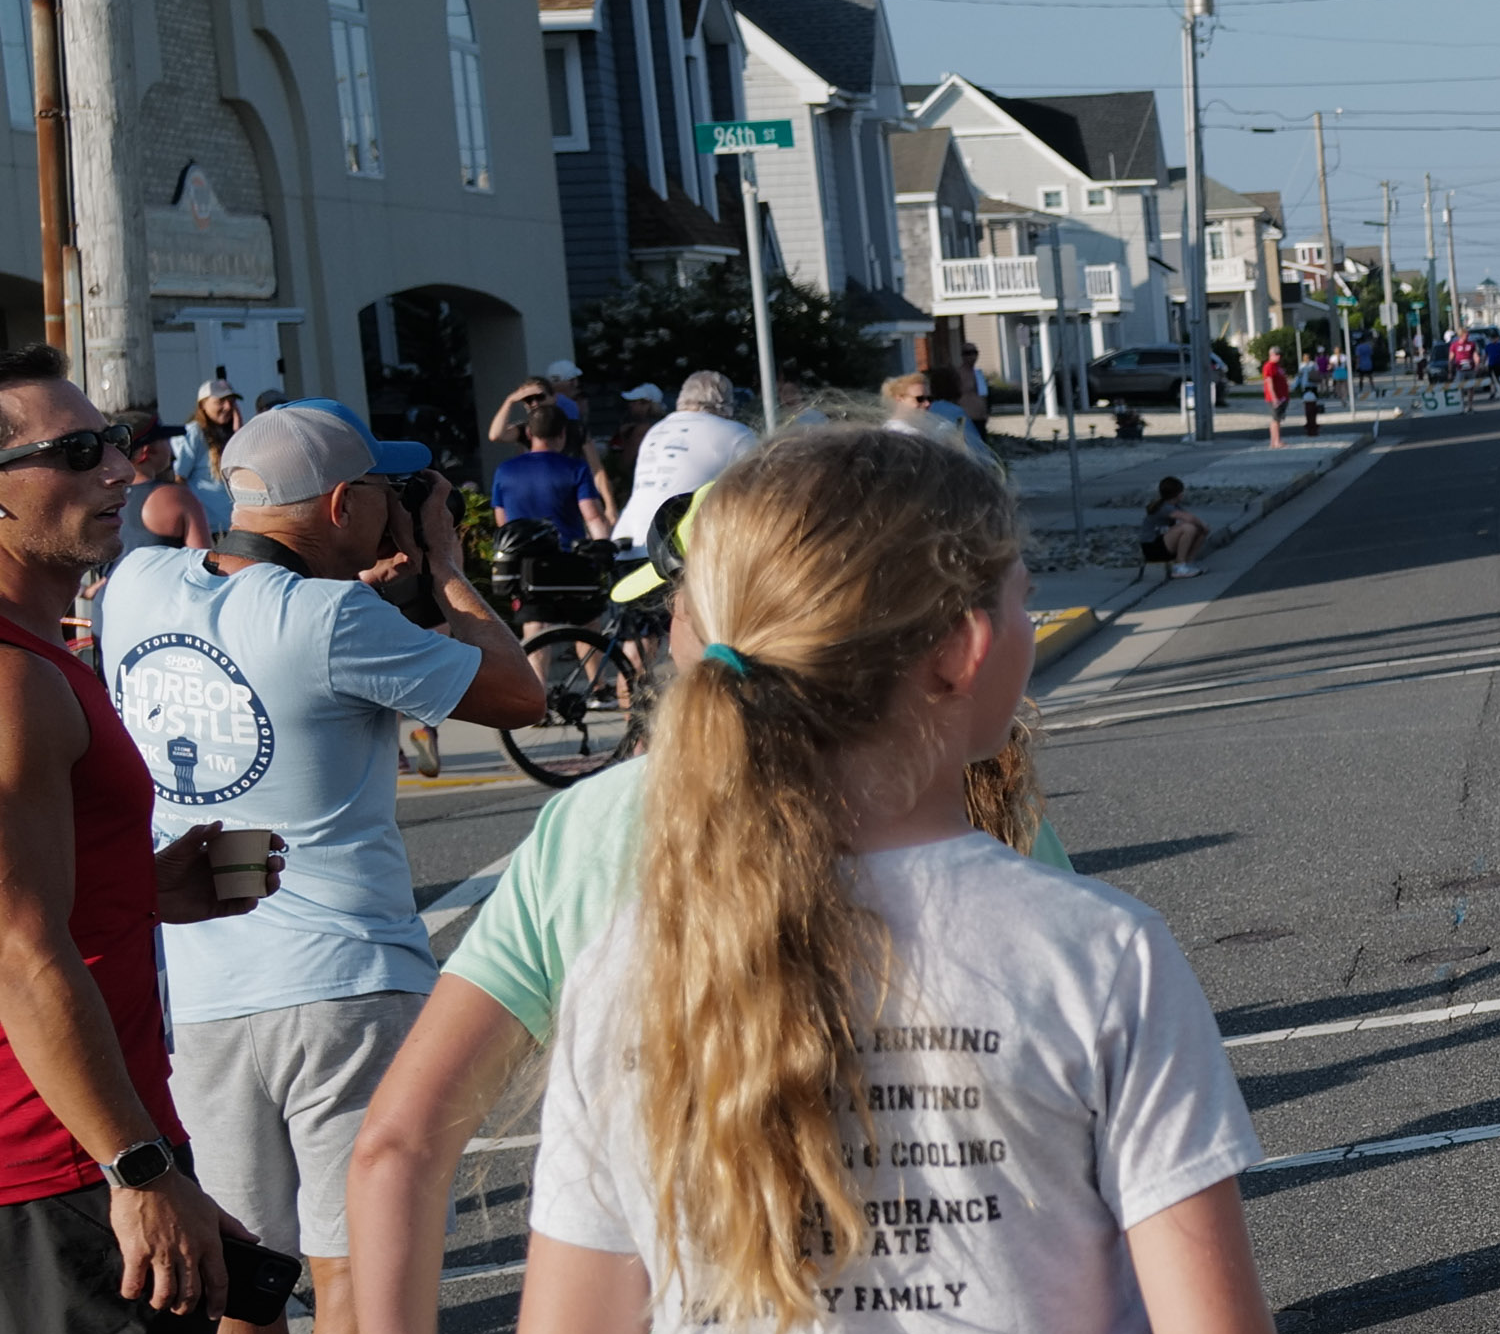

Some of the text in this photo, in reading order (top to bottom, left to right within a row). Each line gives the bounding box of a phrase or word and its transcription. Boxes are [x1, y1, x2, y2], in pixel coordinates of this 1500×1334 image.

[713, 126, 757, 147] 96th
[136, 634, 237, 675] STONE HARBOR
[164, 655, 204, 670] SHPOA
[120, 664, 256, 714] HARBOR
[123, 694, 258, 745] HUSTLE
[204, 753, 236, 774] 1M
[215, 715, 271, 803] ASSOCIATION
[154, 784, 205, 804] NERS
[873, 1026, 1001, 1054] RUNNING
[891, 1139, 1007, 1168] COOLING
[815, 1194, 1002, 1227] ISURANCE
[821, 1227, 932, 1256] EATE
[855, 1282, 967, 1313] FAMILY
